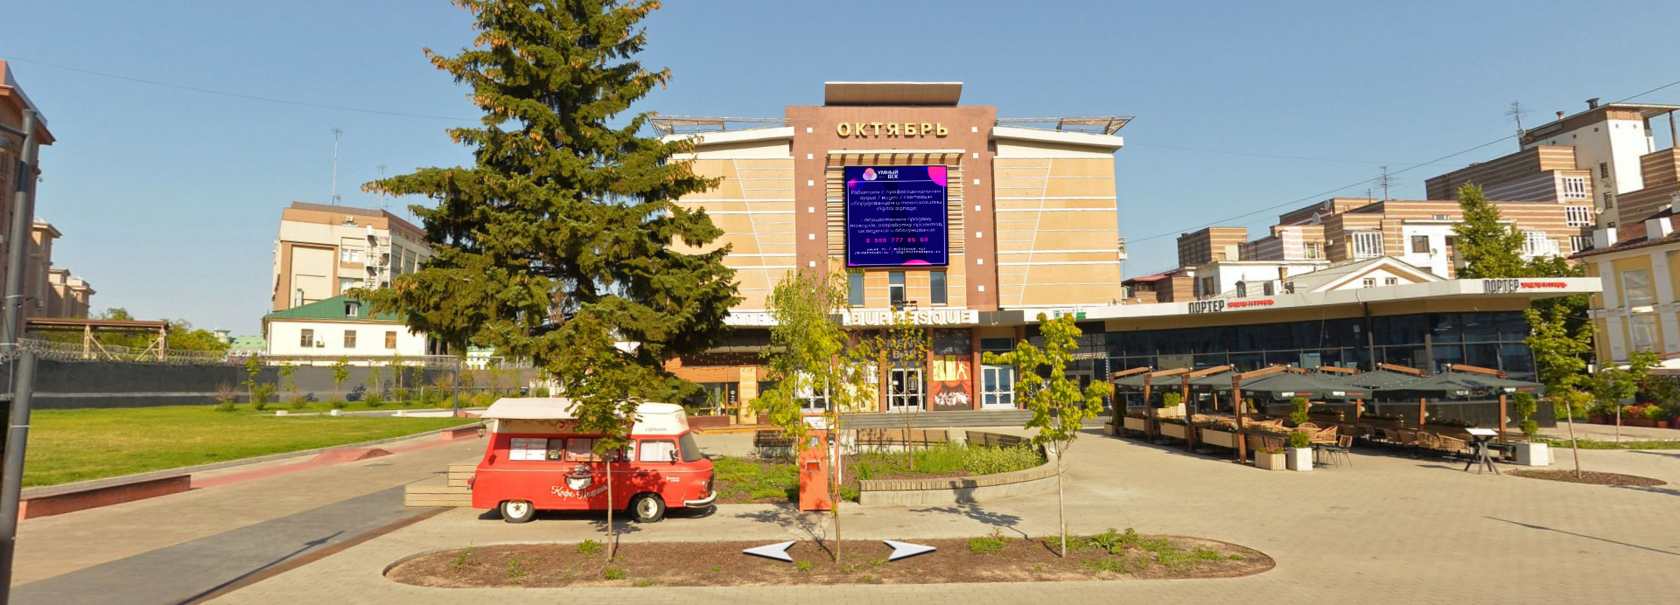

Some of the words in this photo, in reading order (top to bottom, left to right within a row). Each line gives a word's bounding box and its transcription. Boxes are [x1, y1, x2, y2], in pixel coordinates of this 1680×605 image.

[836, 121, 949, 139] ОКТЯБРЬ
[1483, 279, 1519, 293] ПОРТЕР
[1188, 300, 1225, 314] ПОРТЕР
[851, 310, 971, 325] BURESQUE
[551, 485, 576, 501] Кофе
